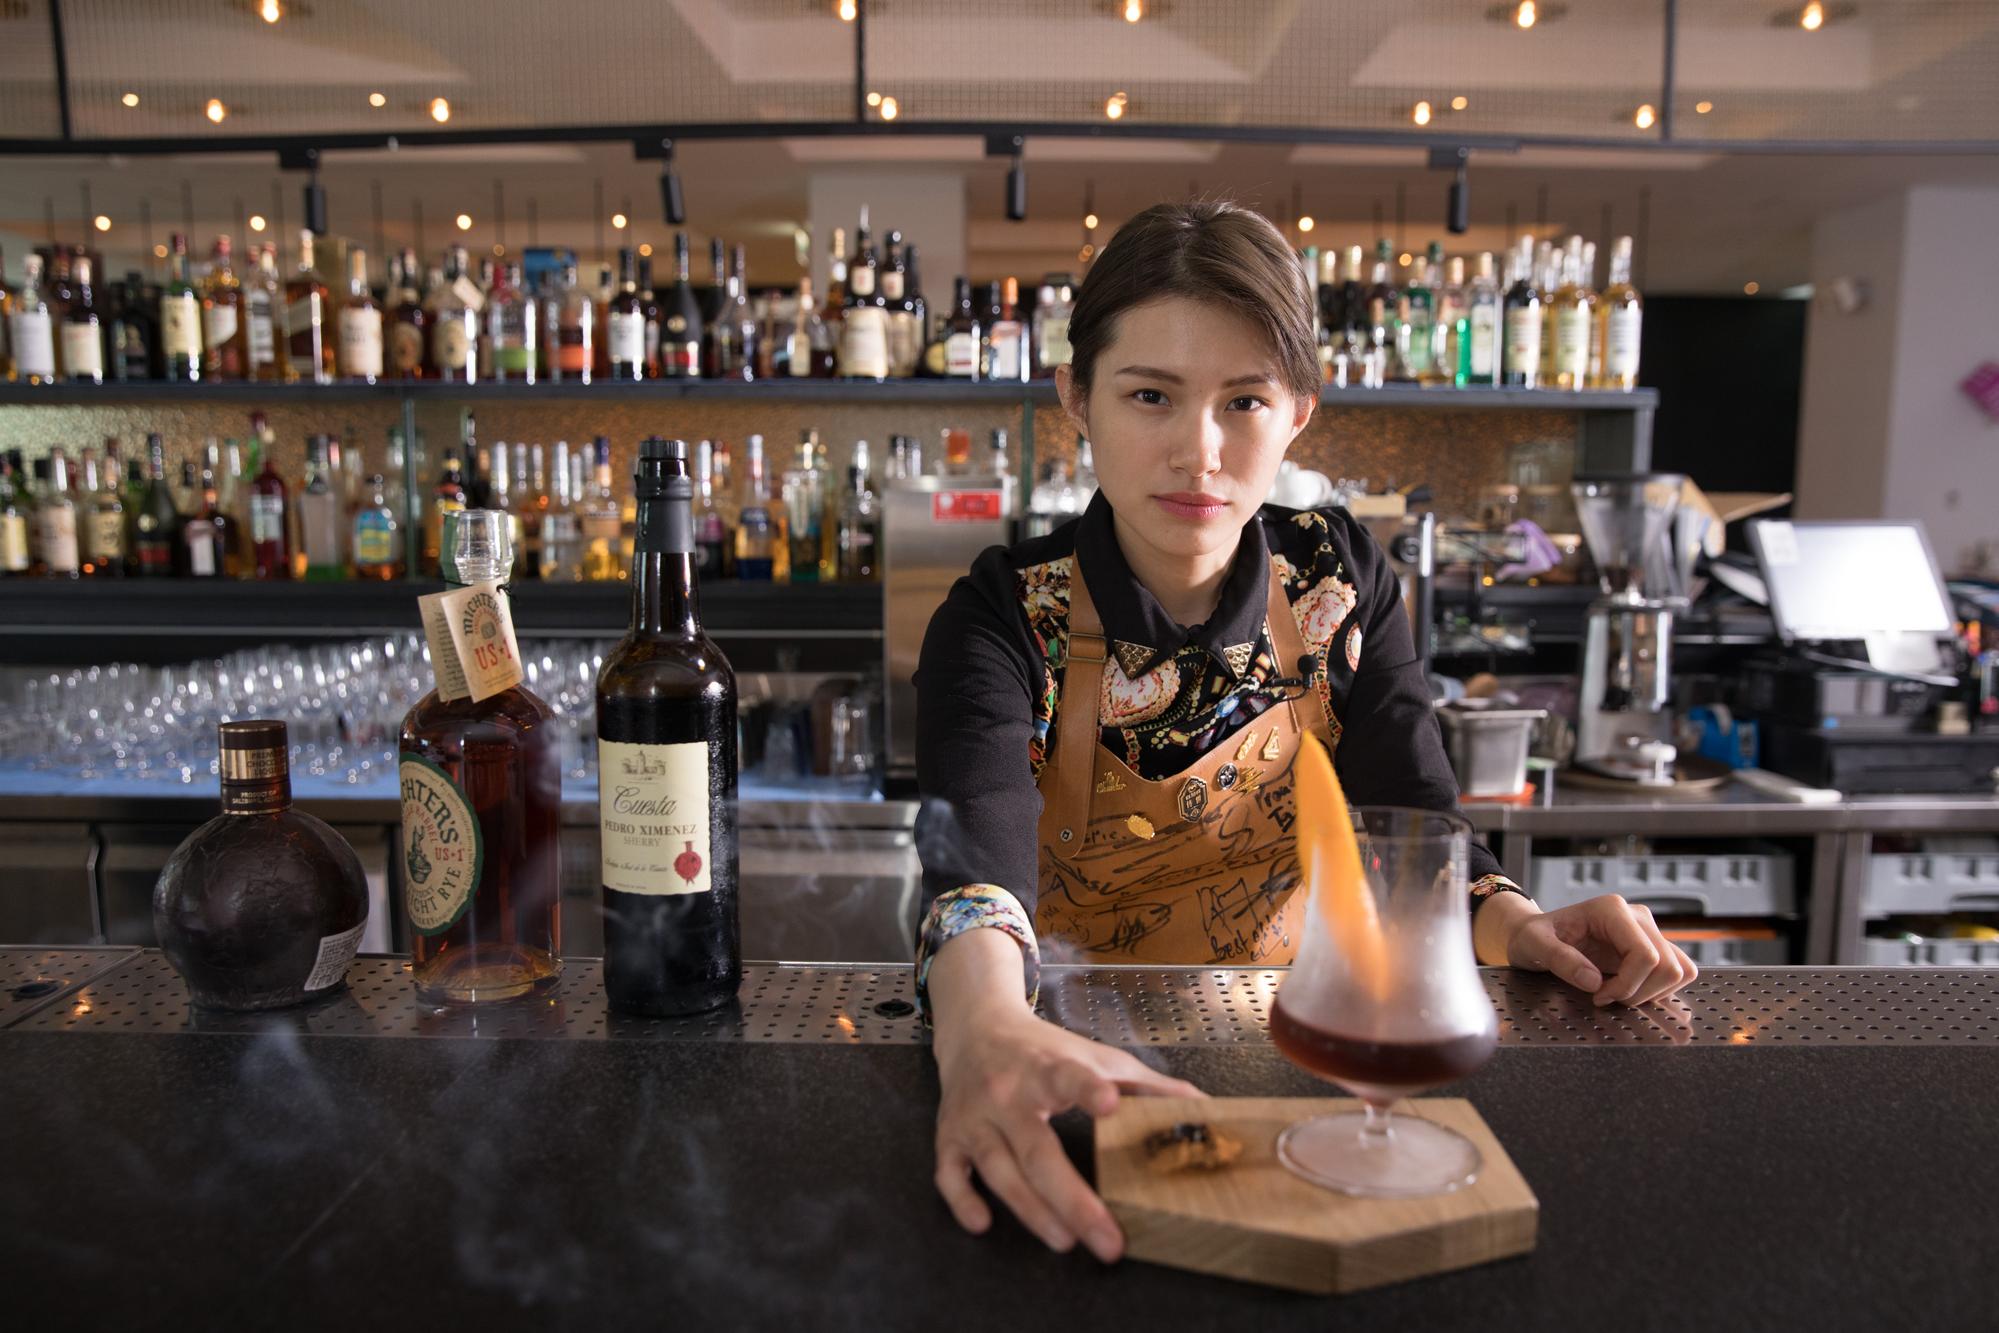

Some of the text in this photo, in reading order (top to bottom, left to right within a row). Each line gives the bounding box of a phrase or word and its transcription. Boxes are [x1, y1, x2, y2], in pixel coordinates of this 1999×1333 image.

[613, 785, 677, 817] Cuesta
[604, 818, 697, 837] PEDRO XIMENEZ
[623, 836, 661, 848] SHERRY
[437, 866, 462, 901] RYE
